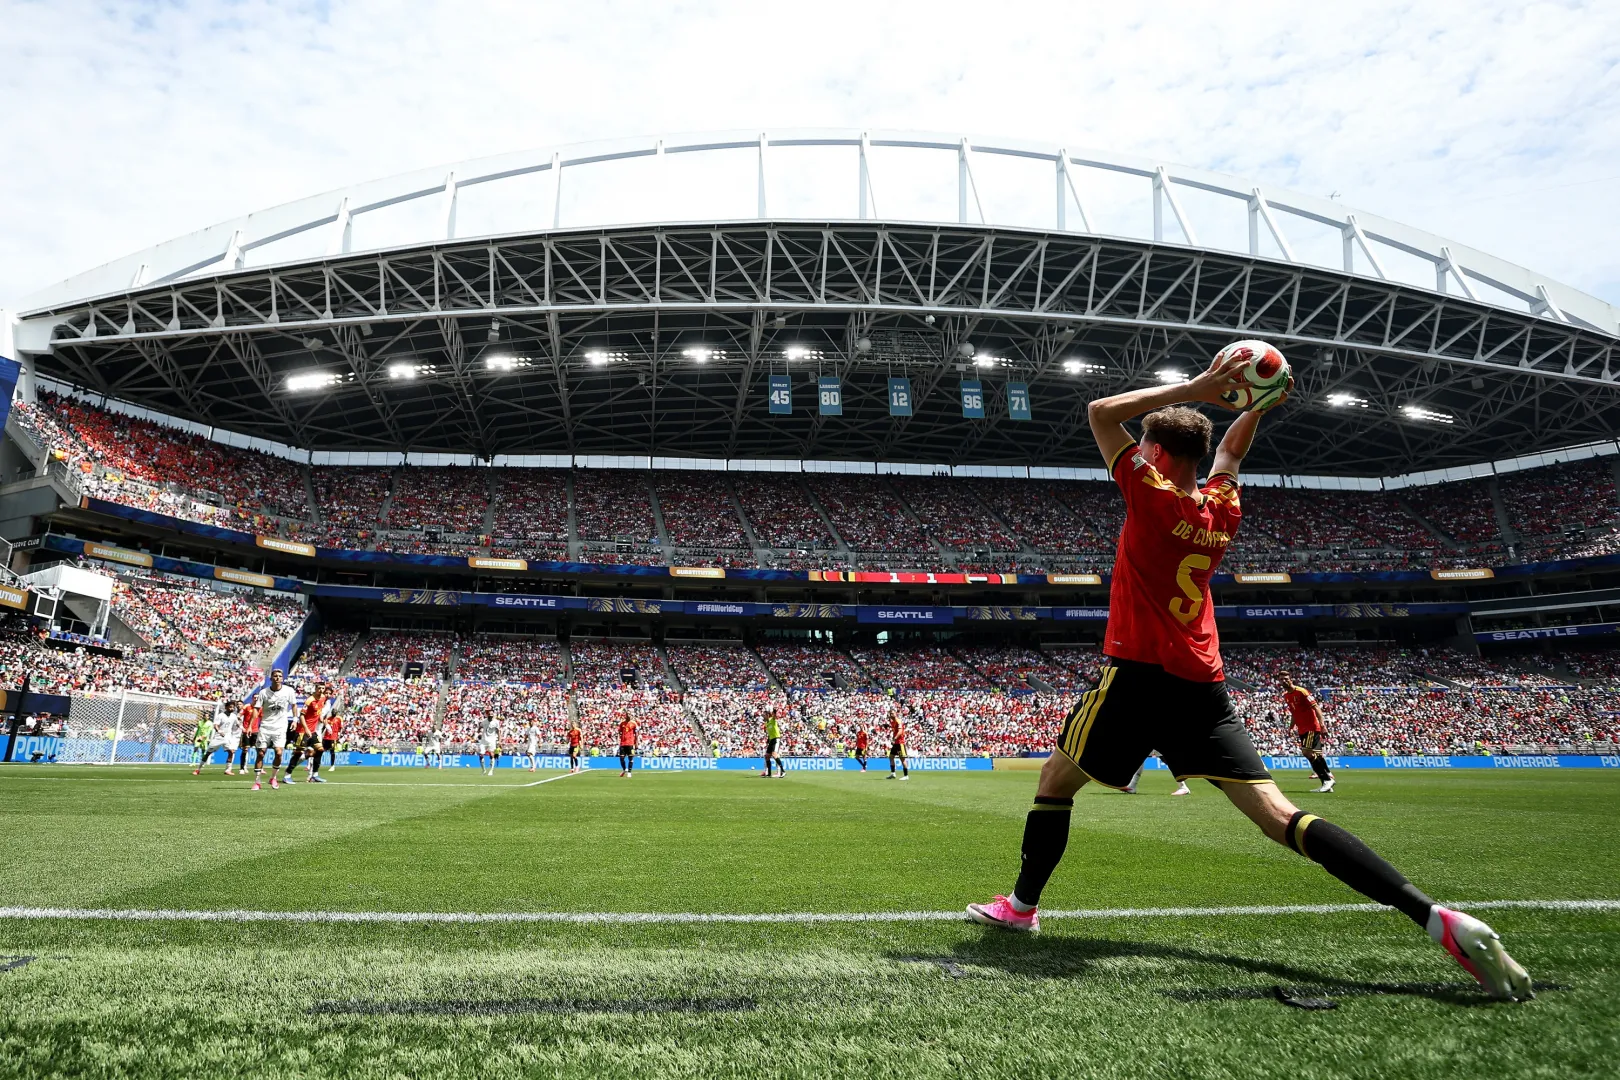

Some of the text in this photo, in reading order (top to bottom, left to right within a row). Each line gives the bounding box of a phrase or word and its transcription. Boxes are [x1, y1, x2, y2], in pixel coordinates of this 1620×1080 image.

[770, 390, 790, 405] 45
[820, 391, 840, 406] 80
[892, 392, 908, 407] 12
[963, 395, 982, 409] 96
[1011, 397, 1027, 411] 71
[1171, 519, 1194, 540] DE
[263, 539, 309, 553] SUBSTITUTION
[92, 547, 145, 563] SUBSTITUTION
[475, 560, 521, 568] SUBSTITUTION
[221, 571, 267, 584] SUBSTITUTION
[889, 572, 938, 584] 1 1
[1168, 553, 1211, 626] 5
[495, 597, 556, 607] SEATTLE
[697, 604, 744, 614] #FIFAWorldCup
[877, 611, 933, 619] SEATTLE
[1246, 608, 1304, 616] SEATTLE
[1492, 627, 1579, 641] SEATTLE
[381, 754, 461, 767] POWERADE
[641, 757, 718, 769] POWERADE
[1383, 756, 1452, 767] POWERADE
[1493, 756, 1560, 768] POWERADE
